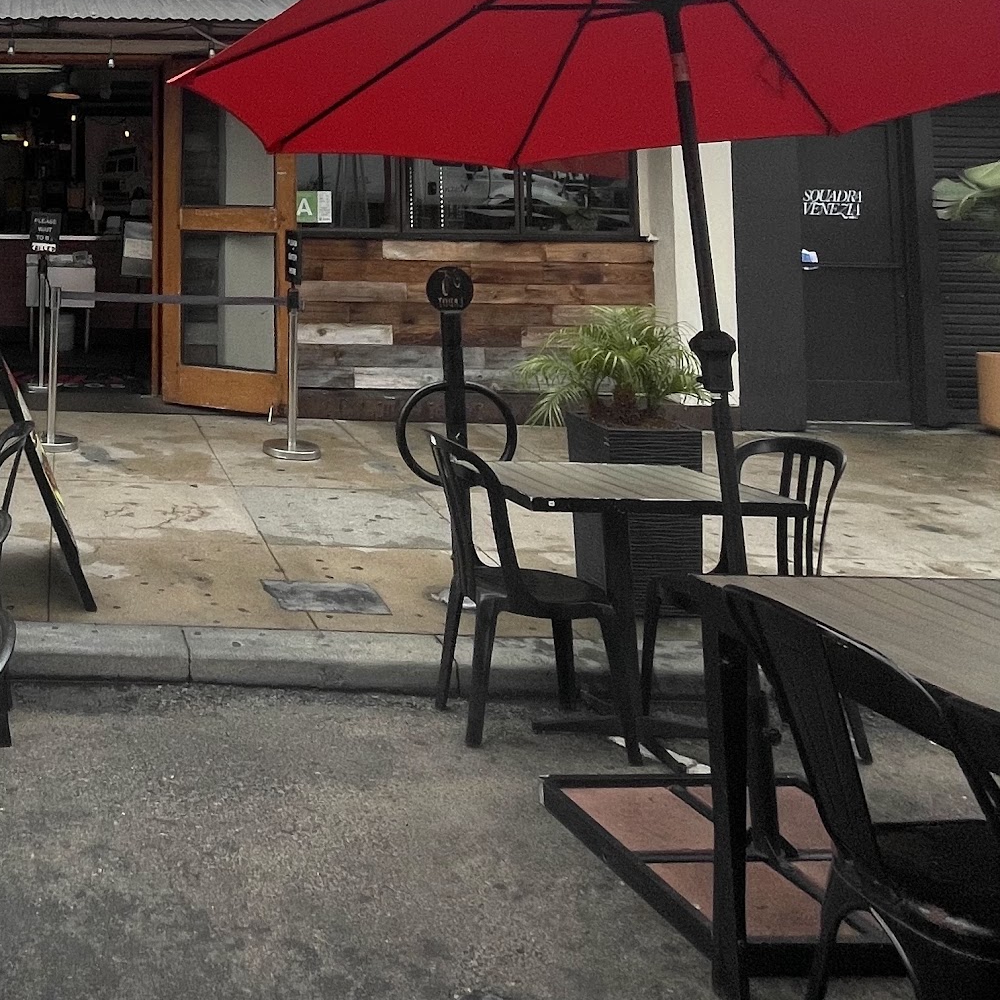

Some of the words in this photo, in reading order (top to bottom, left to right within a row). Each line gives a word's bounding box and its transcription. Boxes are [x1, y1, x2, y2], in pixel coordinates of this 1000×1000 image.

[803, 189, 862, 203] SQUADRA
[296, 197, 313, 216] A
[803, 202, 861, 219] VENEZIA
